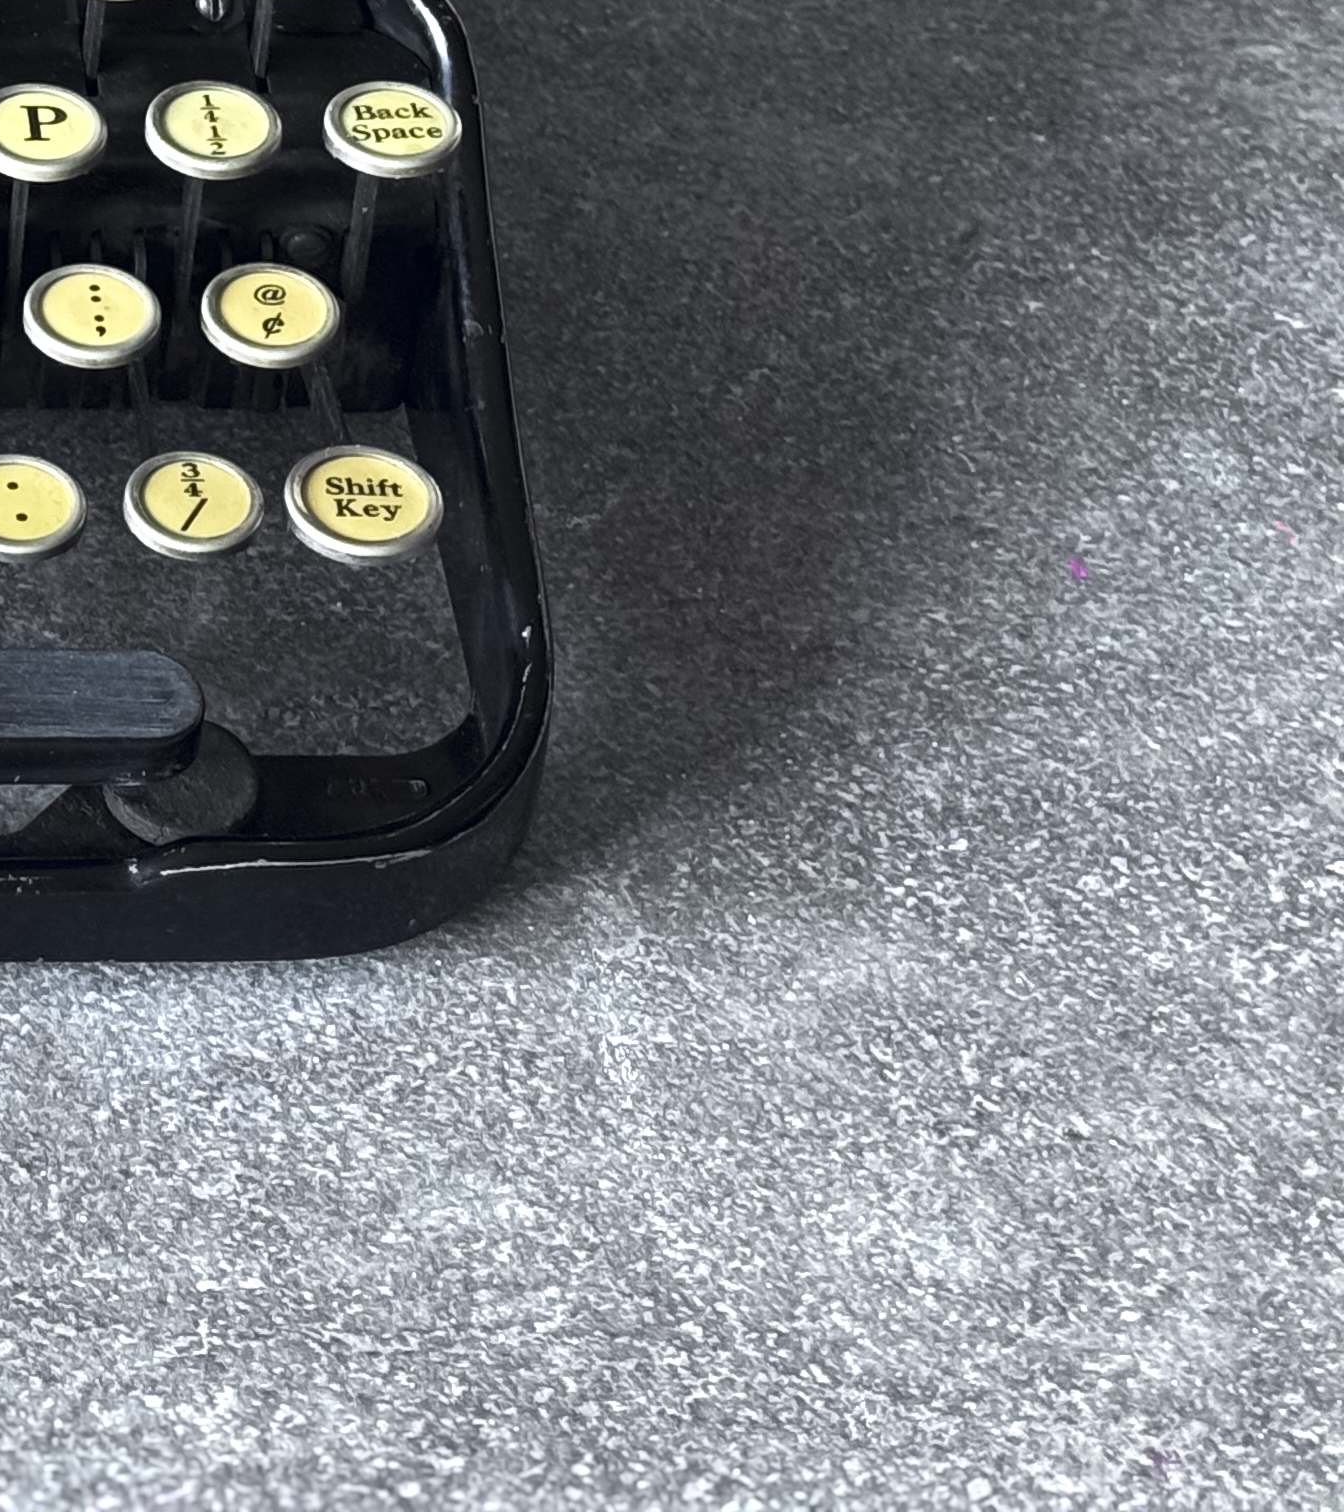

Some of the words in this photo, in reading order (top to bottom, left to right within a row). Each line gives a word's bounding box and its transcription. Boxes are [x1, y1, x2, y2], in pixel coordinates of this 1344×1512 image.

[350, 102, 432, 121] Back
[20, 105, 68, 142] P
[350, 119, 444, 143] Space
[253, 284, 287, 306] @
[324, 476, 405, 499] Shift
[334, 499, 404, 522] Key
